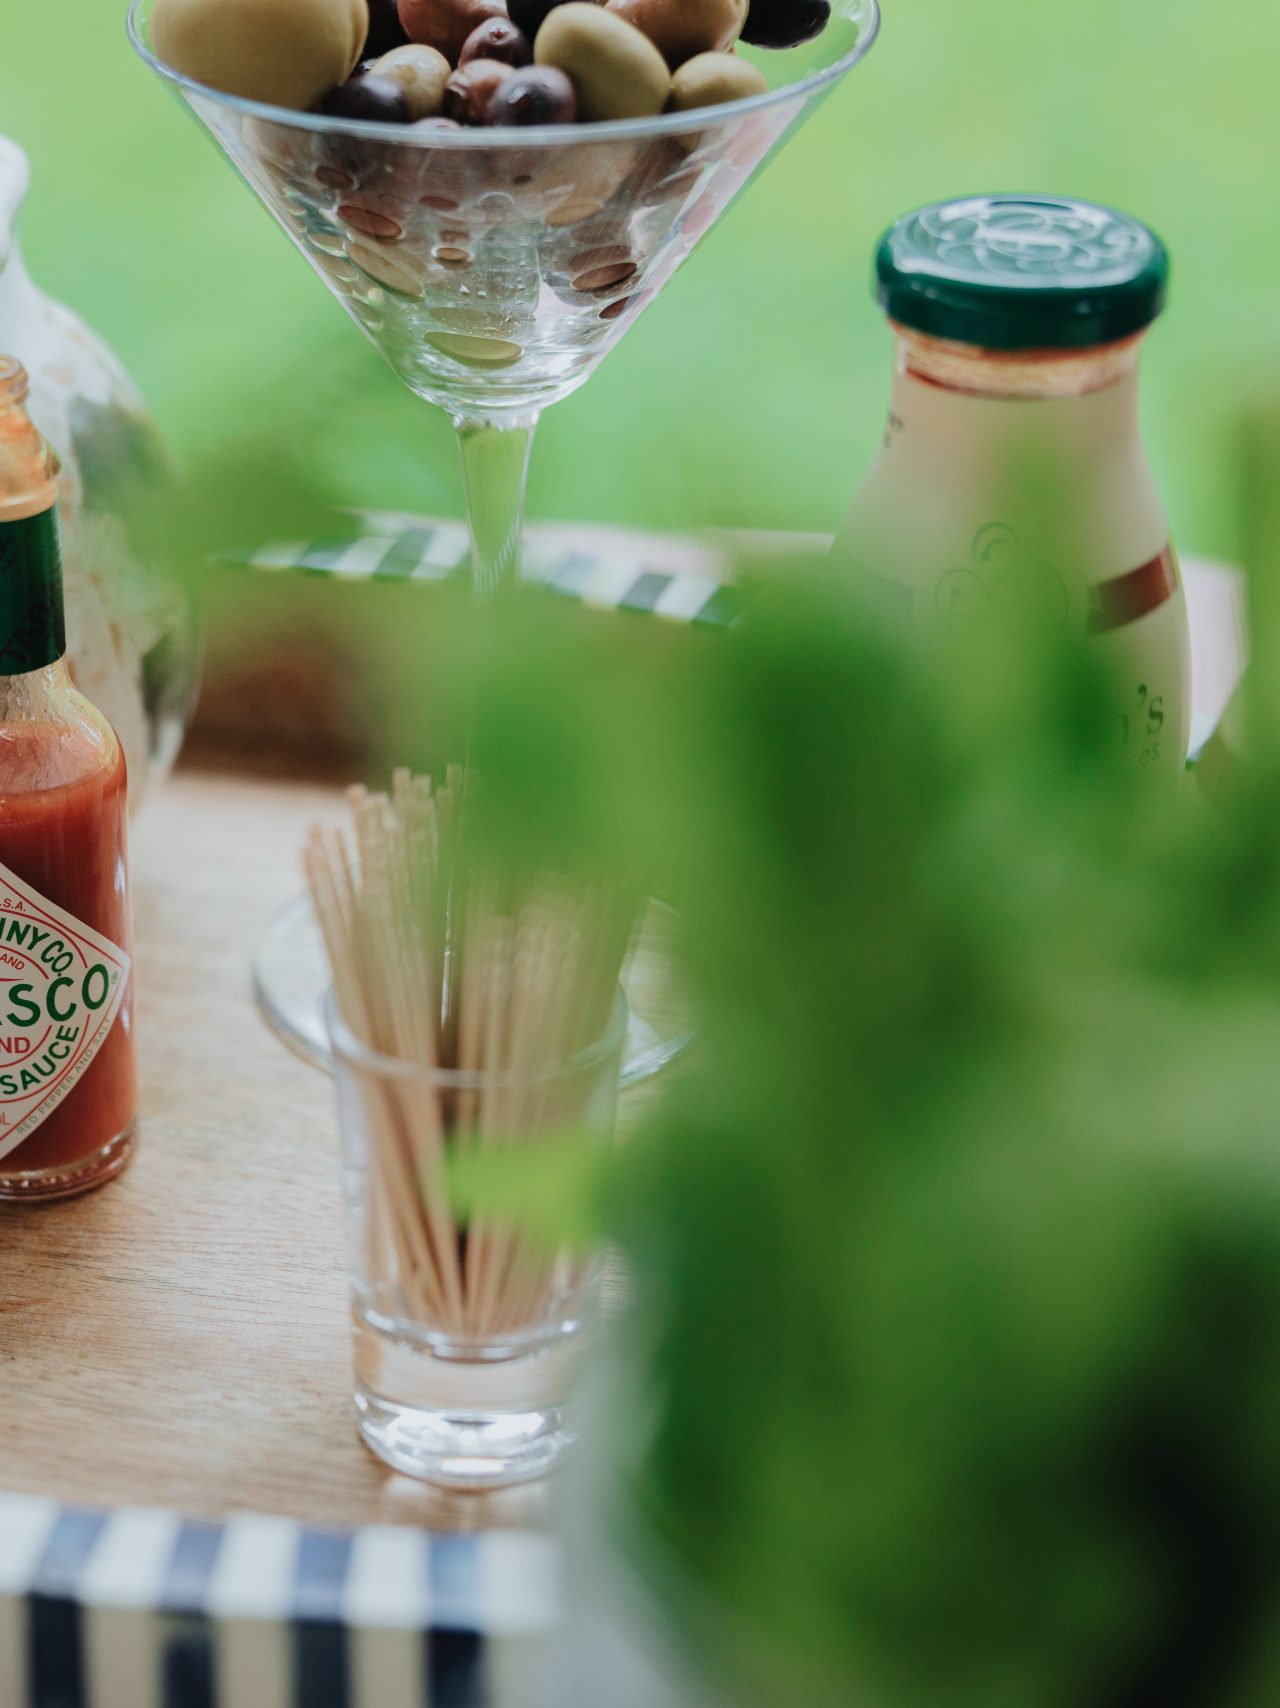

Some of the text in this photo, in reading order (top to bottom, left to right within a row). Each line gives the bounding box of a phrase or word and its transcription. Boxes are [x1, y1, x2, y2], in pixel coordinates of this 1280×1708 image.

[0, 1025, 79, 1095] SAUCE
[38, 1075, 75, 1115] PEPPER
[75, 1049, 94, 1073] AND
